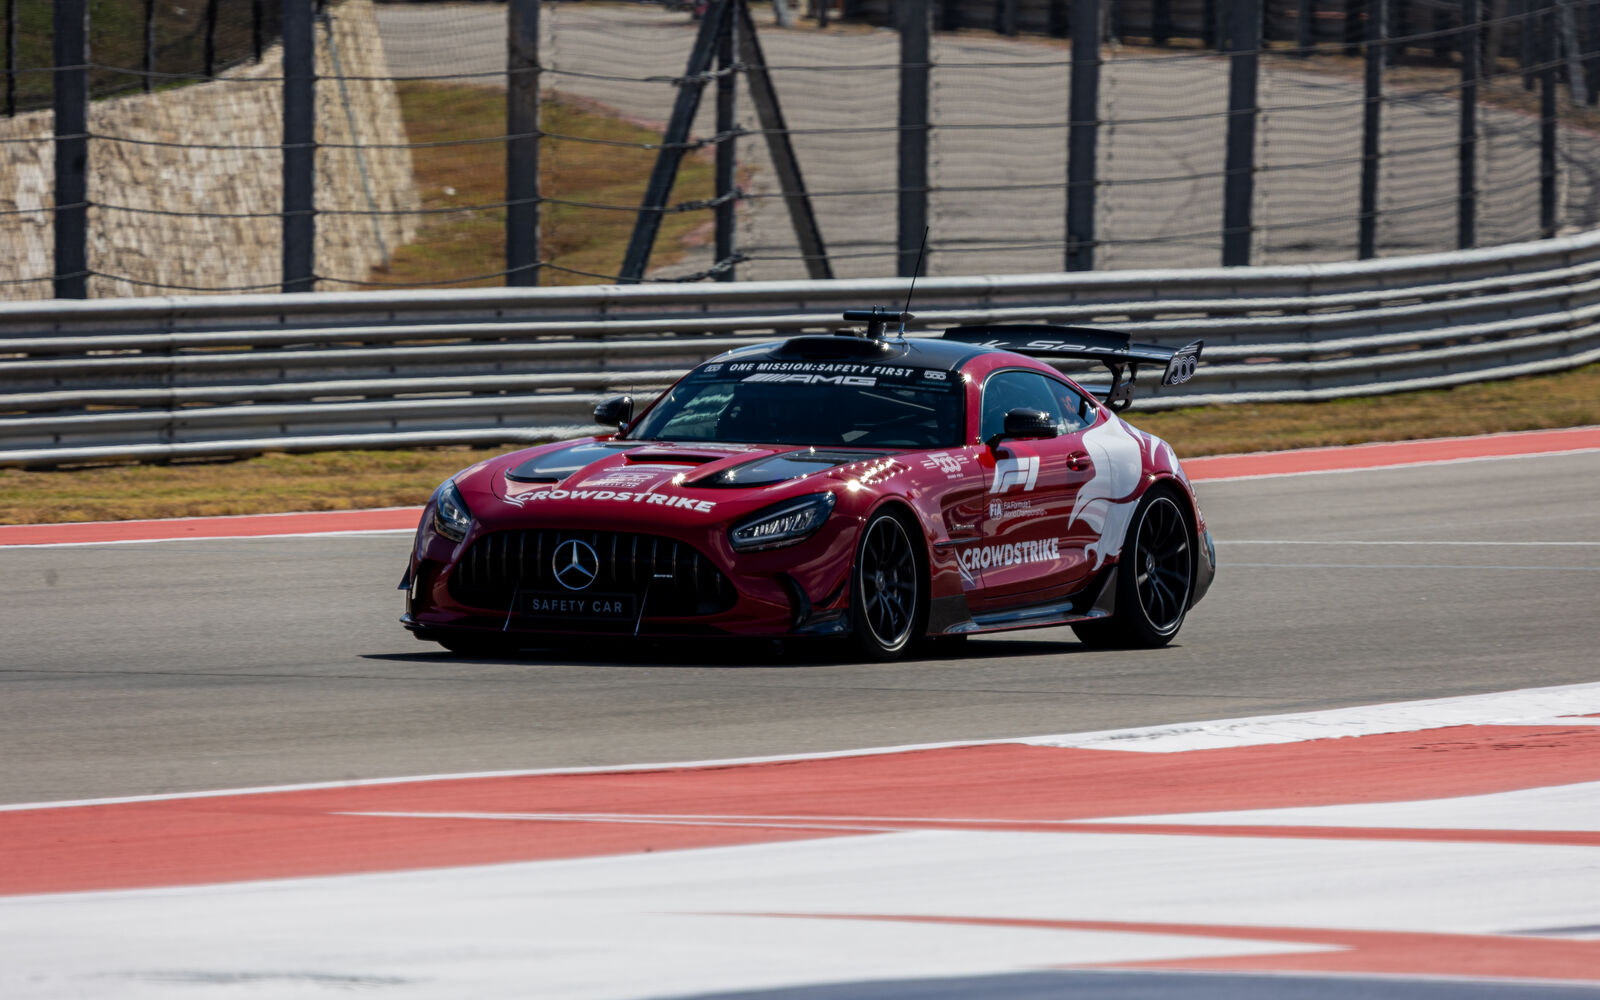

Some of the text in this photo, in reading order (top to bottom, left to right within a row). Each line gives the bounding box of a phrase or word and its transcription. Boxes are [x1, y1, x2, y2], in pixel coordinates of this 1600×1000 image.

[729, 363, 755, 371] ONE
[871, 366, 914, 377] FIRST
[518, 490, 717, 513] CROWDSTRIKE
[962, 538, 1060, 570] CROWDSTRIKE
[532, 599, 623, 613] SAFETY CAR
